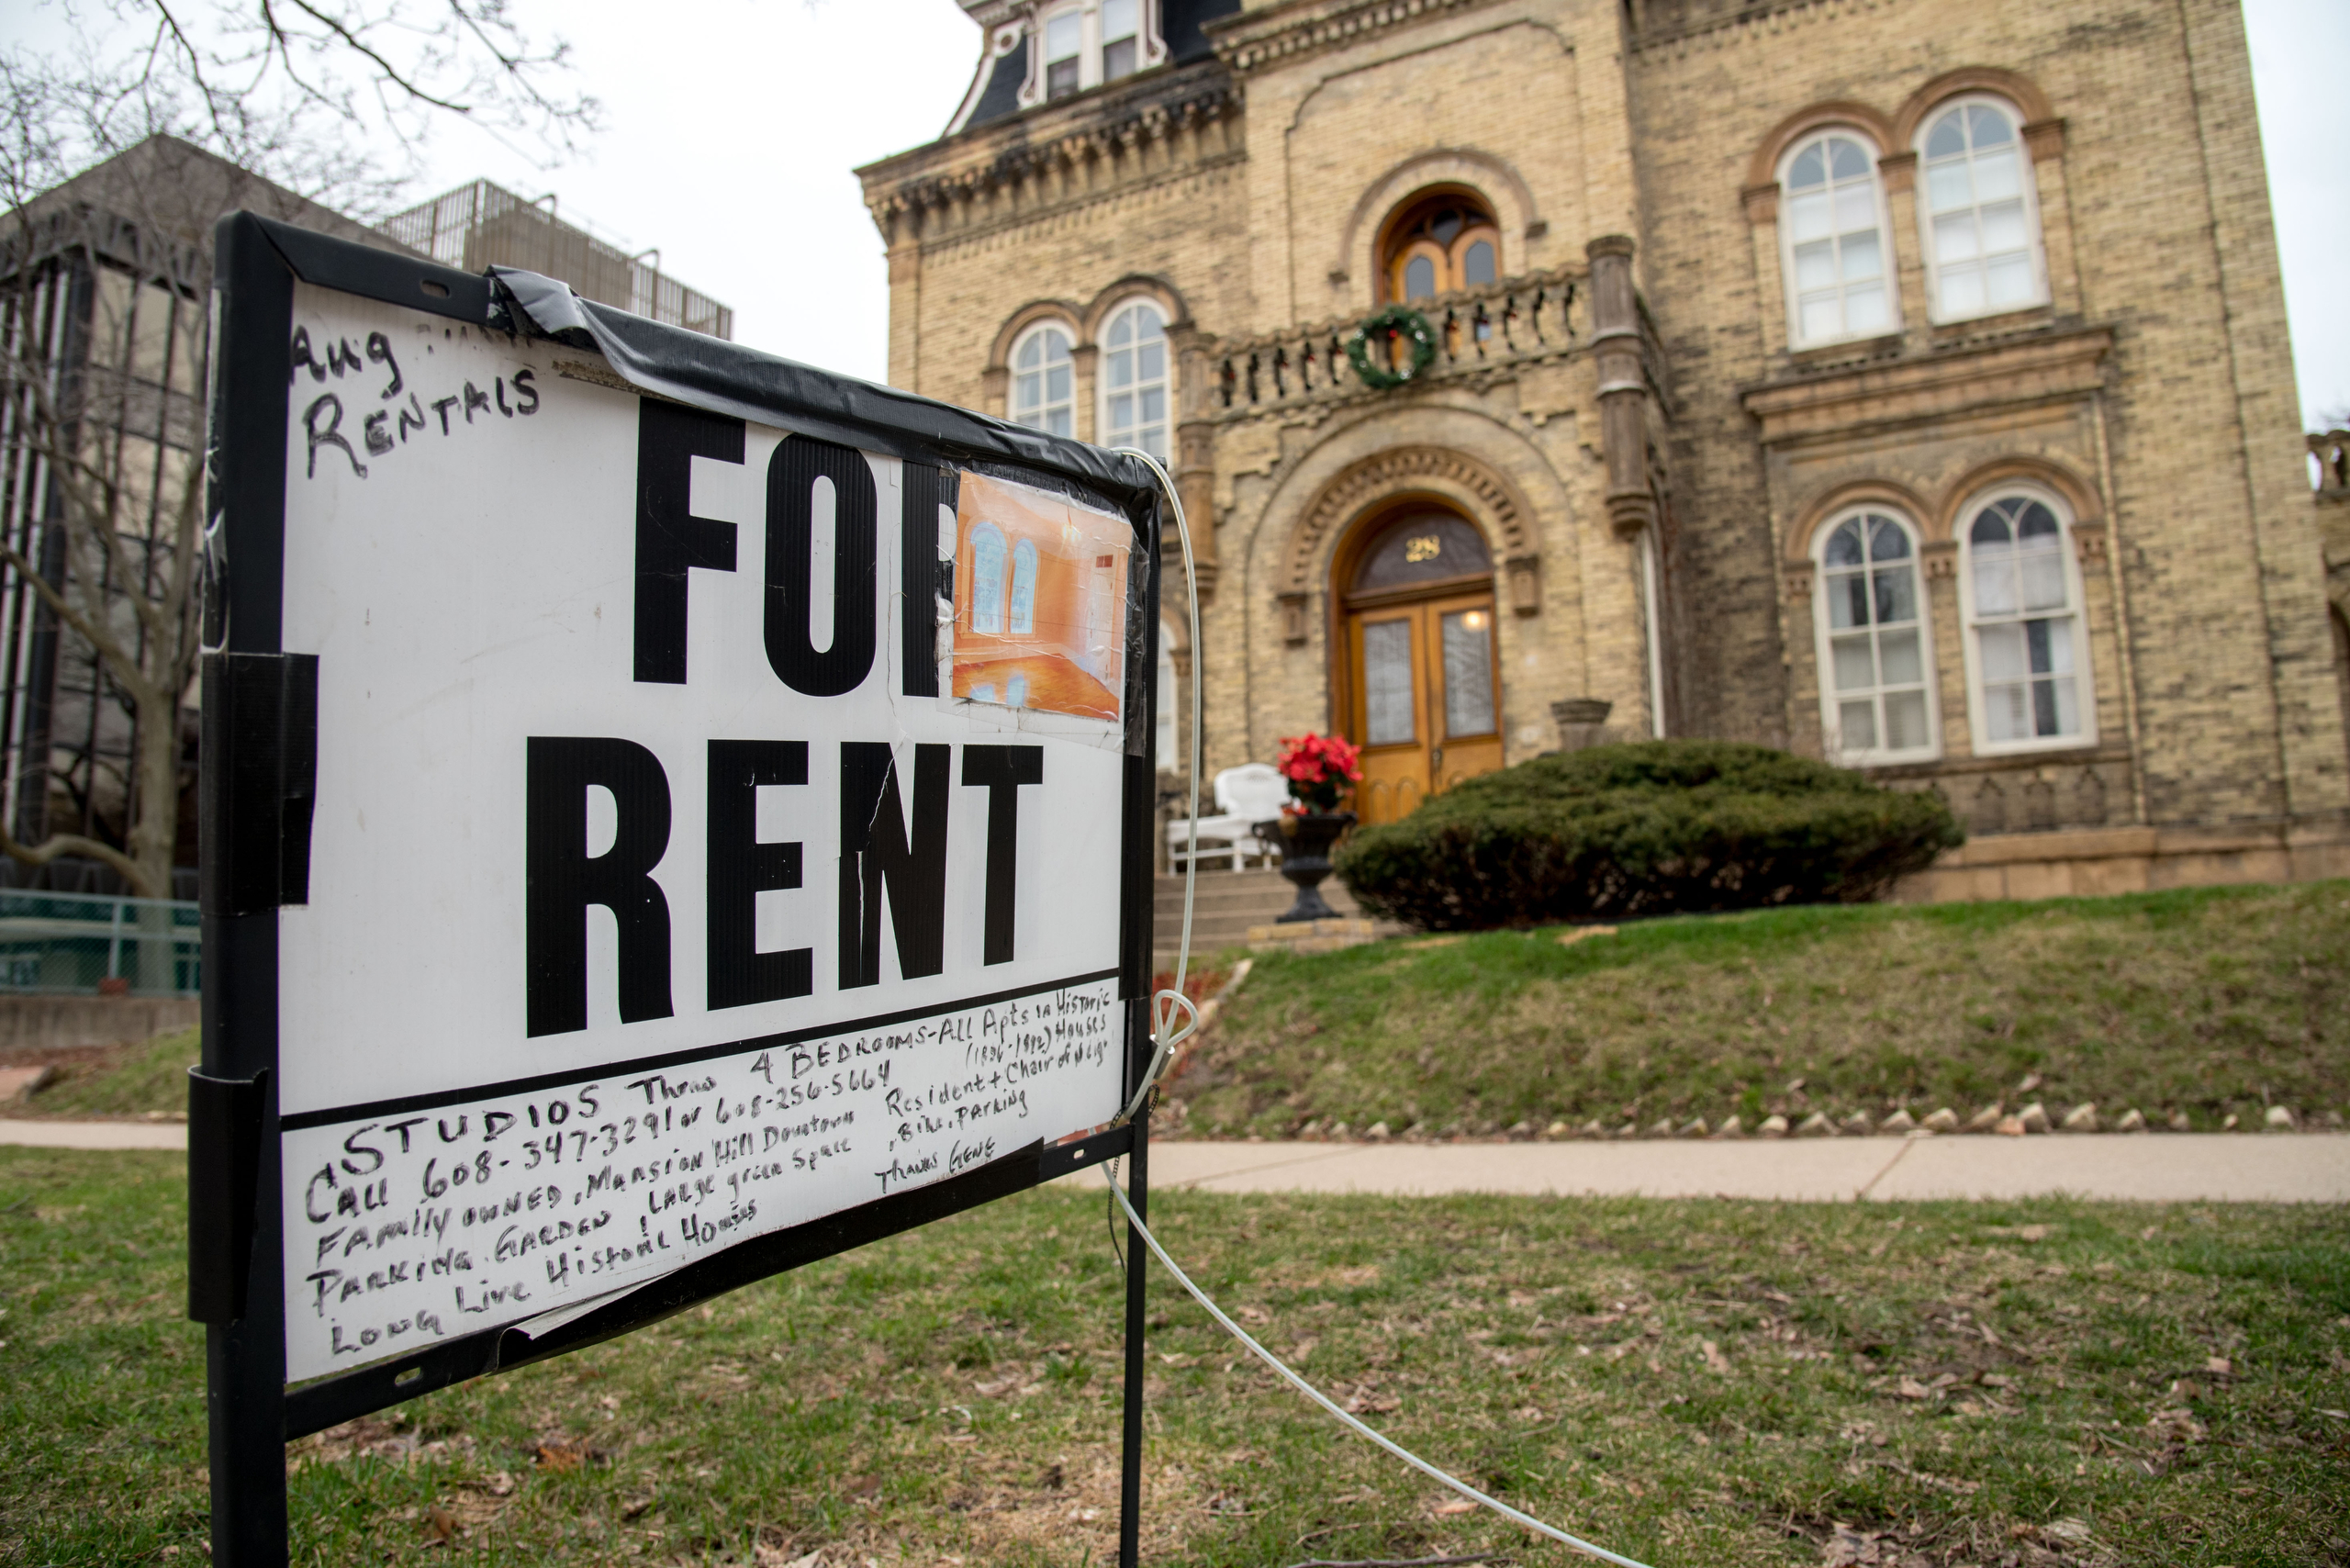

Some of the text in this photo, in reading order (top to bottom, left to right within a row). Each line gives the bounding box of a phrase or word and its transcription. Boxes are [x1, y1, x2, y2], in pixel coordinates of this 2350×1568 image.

[303, 369, 540, 479] RENTALS
[1405, 534, 1440, 563] 28
[526, 736, 1044, 1038] RENT
[341, 1084, 601, 1175] STUDIOS
[750, 1051, 774, 1084] 4
[983, 1002, 1029, 1044] Apts
[886, 1074, 985, 1117] Resident
[1005, 1057, 1054, 1084] Chair
